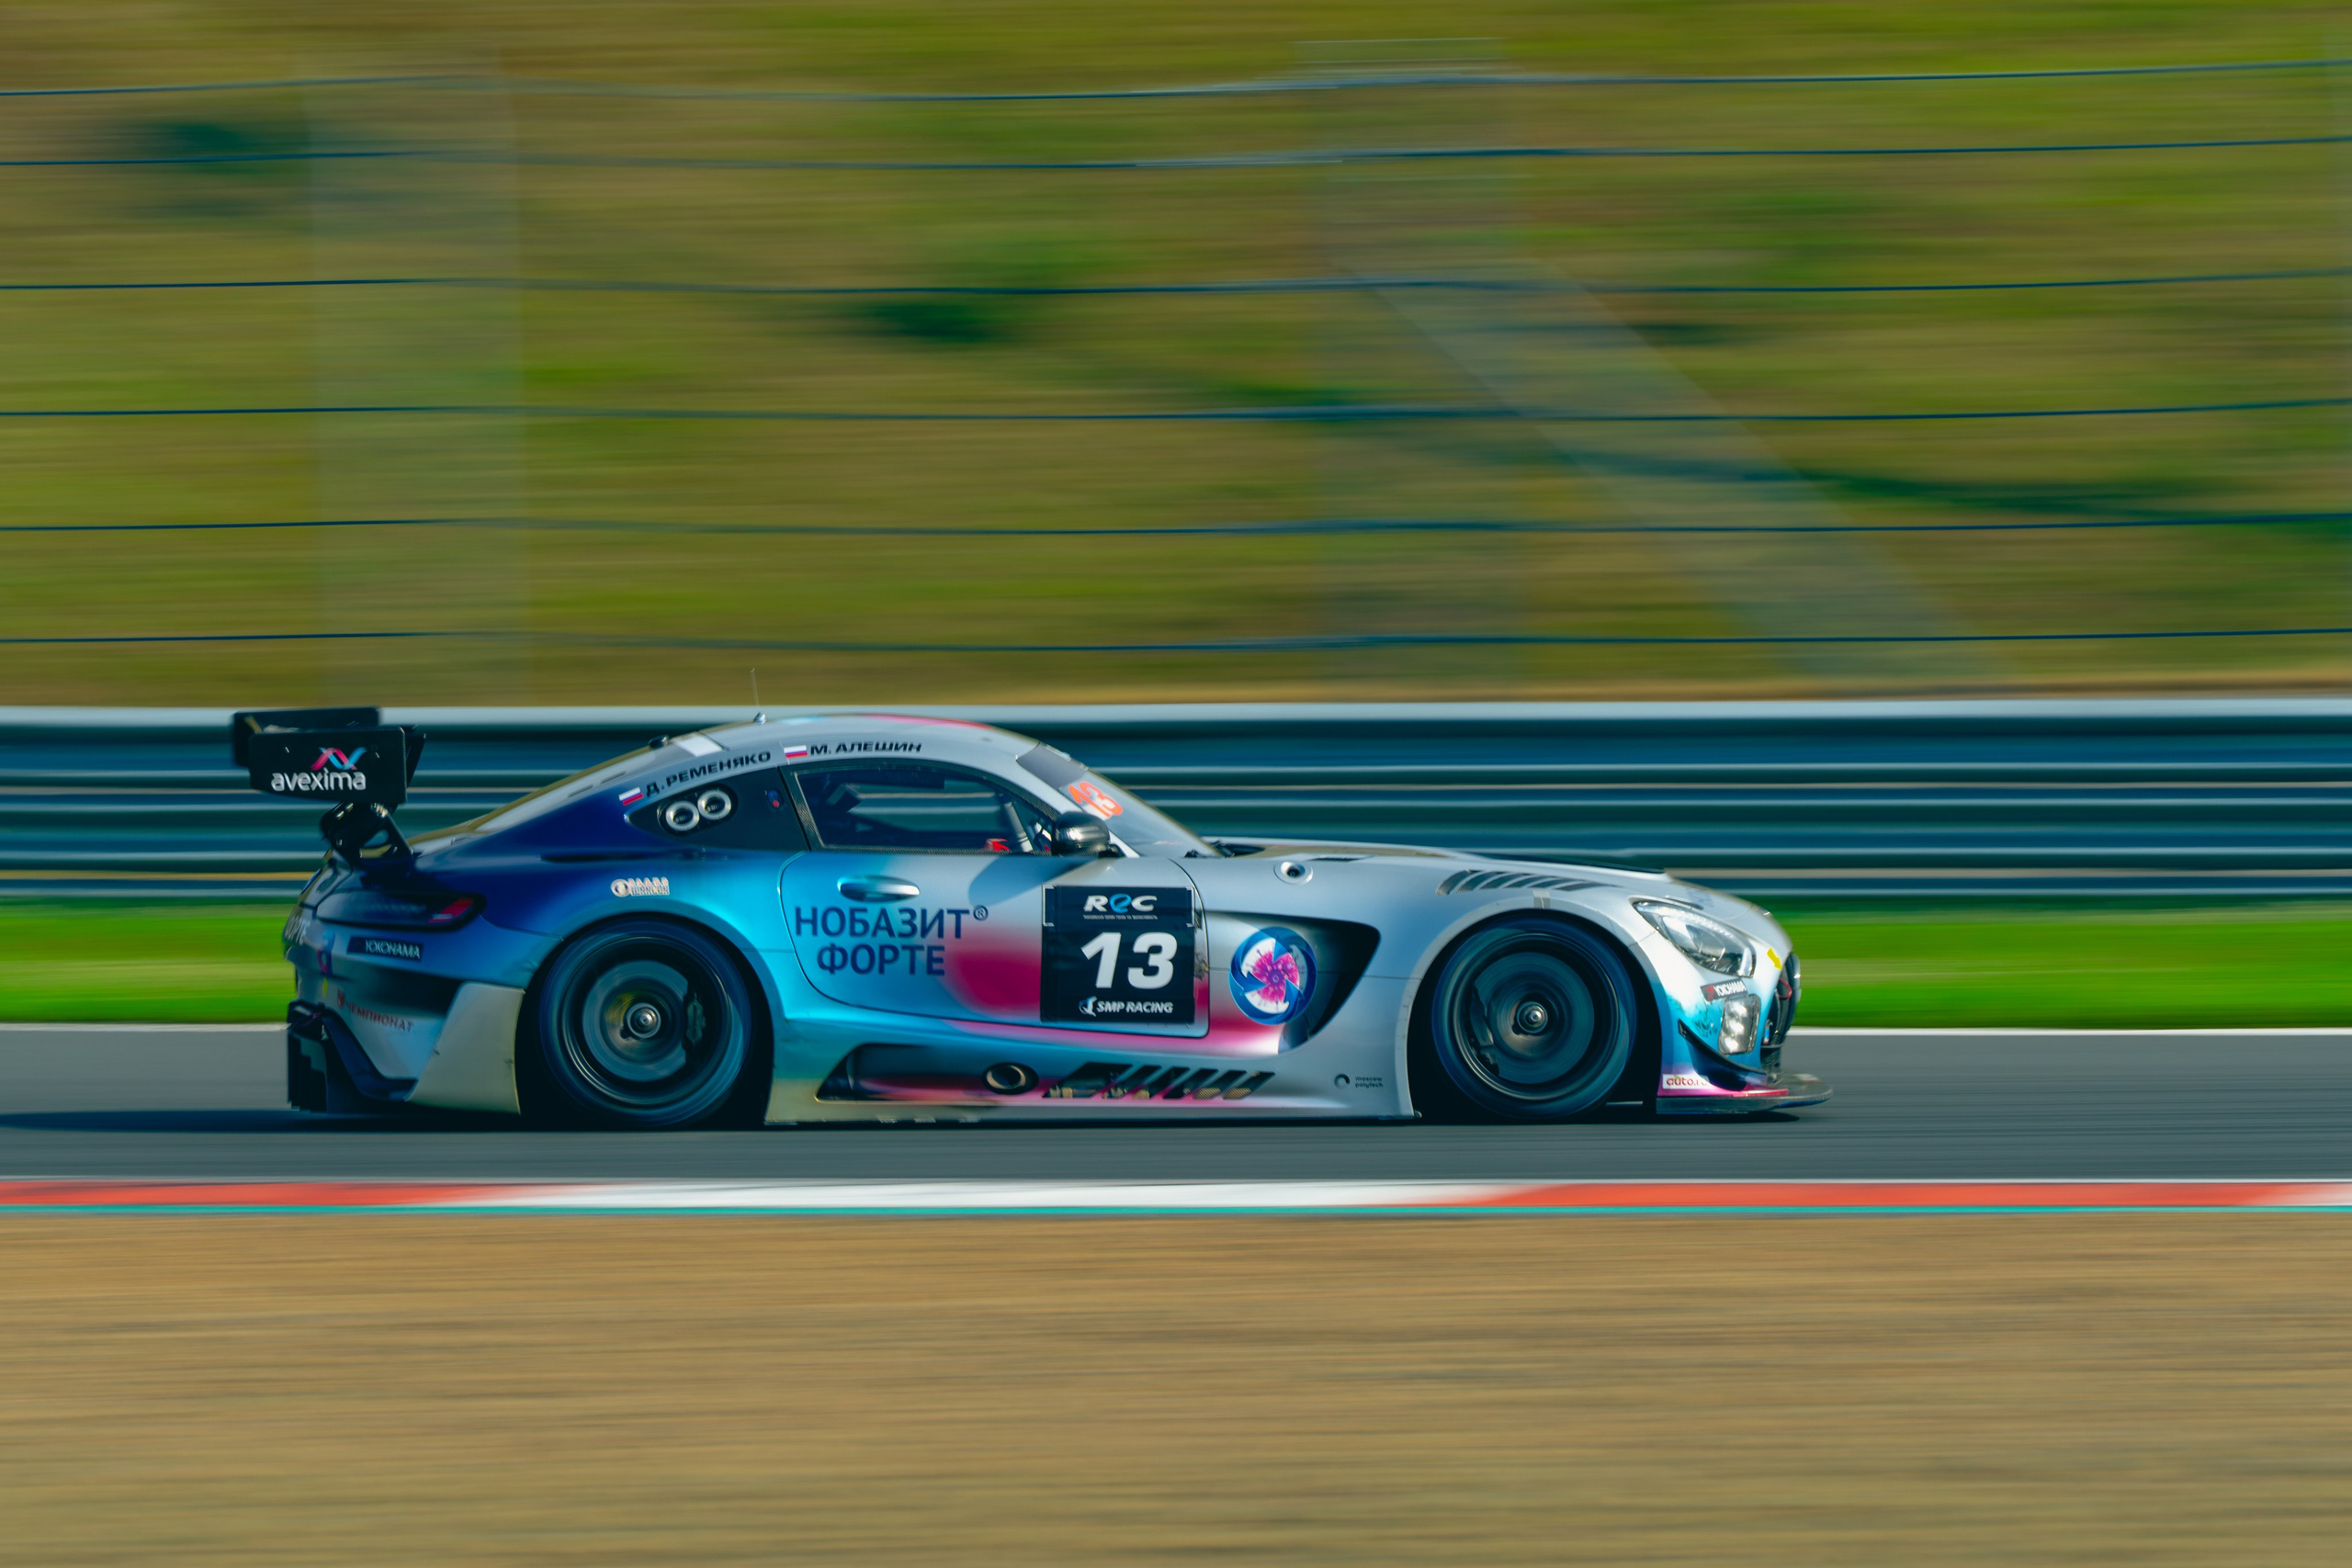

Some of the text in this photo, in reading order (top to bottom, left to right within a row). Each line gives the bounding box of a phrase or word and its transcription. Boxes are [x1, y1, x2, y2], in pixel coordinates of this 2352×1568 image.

[809, 740, 922, 756] М. АЛЕШИН
[270, 768, 367, 792] avexima
[645, 750, 772, 798] Д. РЕМЕНЯКО
[1068, 781, 1124, 818] 13
[365, 938, 421, 959] YOKOHAMA
[817, 942, 945, 976] ФОРТЕ
[1080, 931, 1179, 990] 13
[1096, 1000, 1174, 1014] SMP RACING
